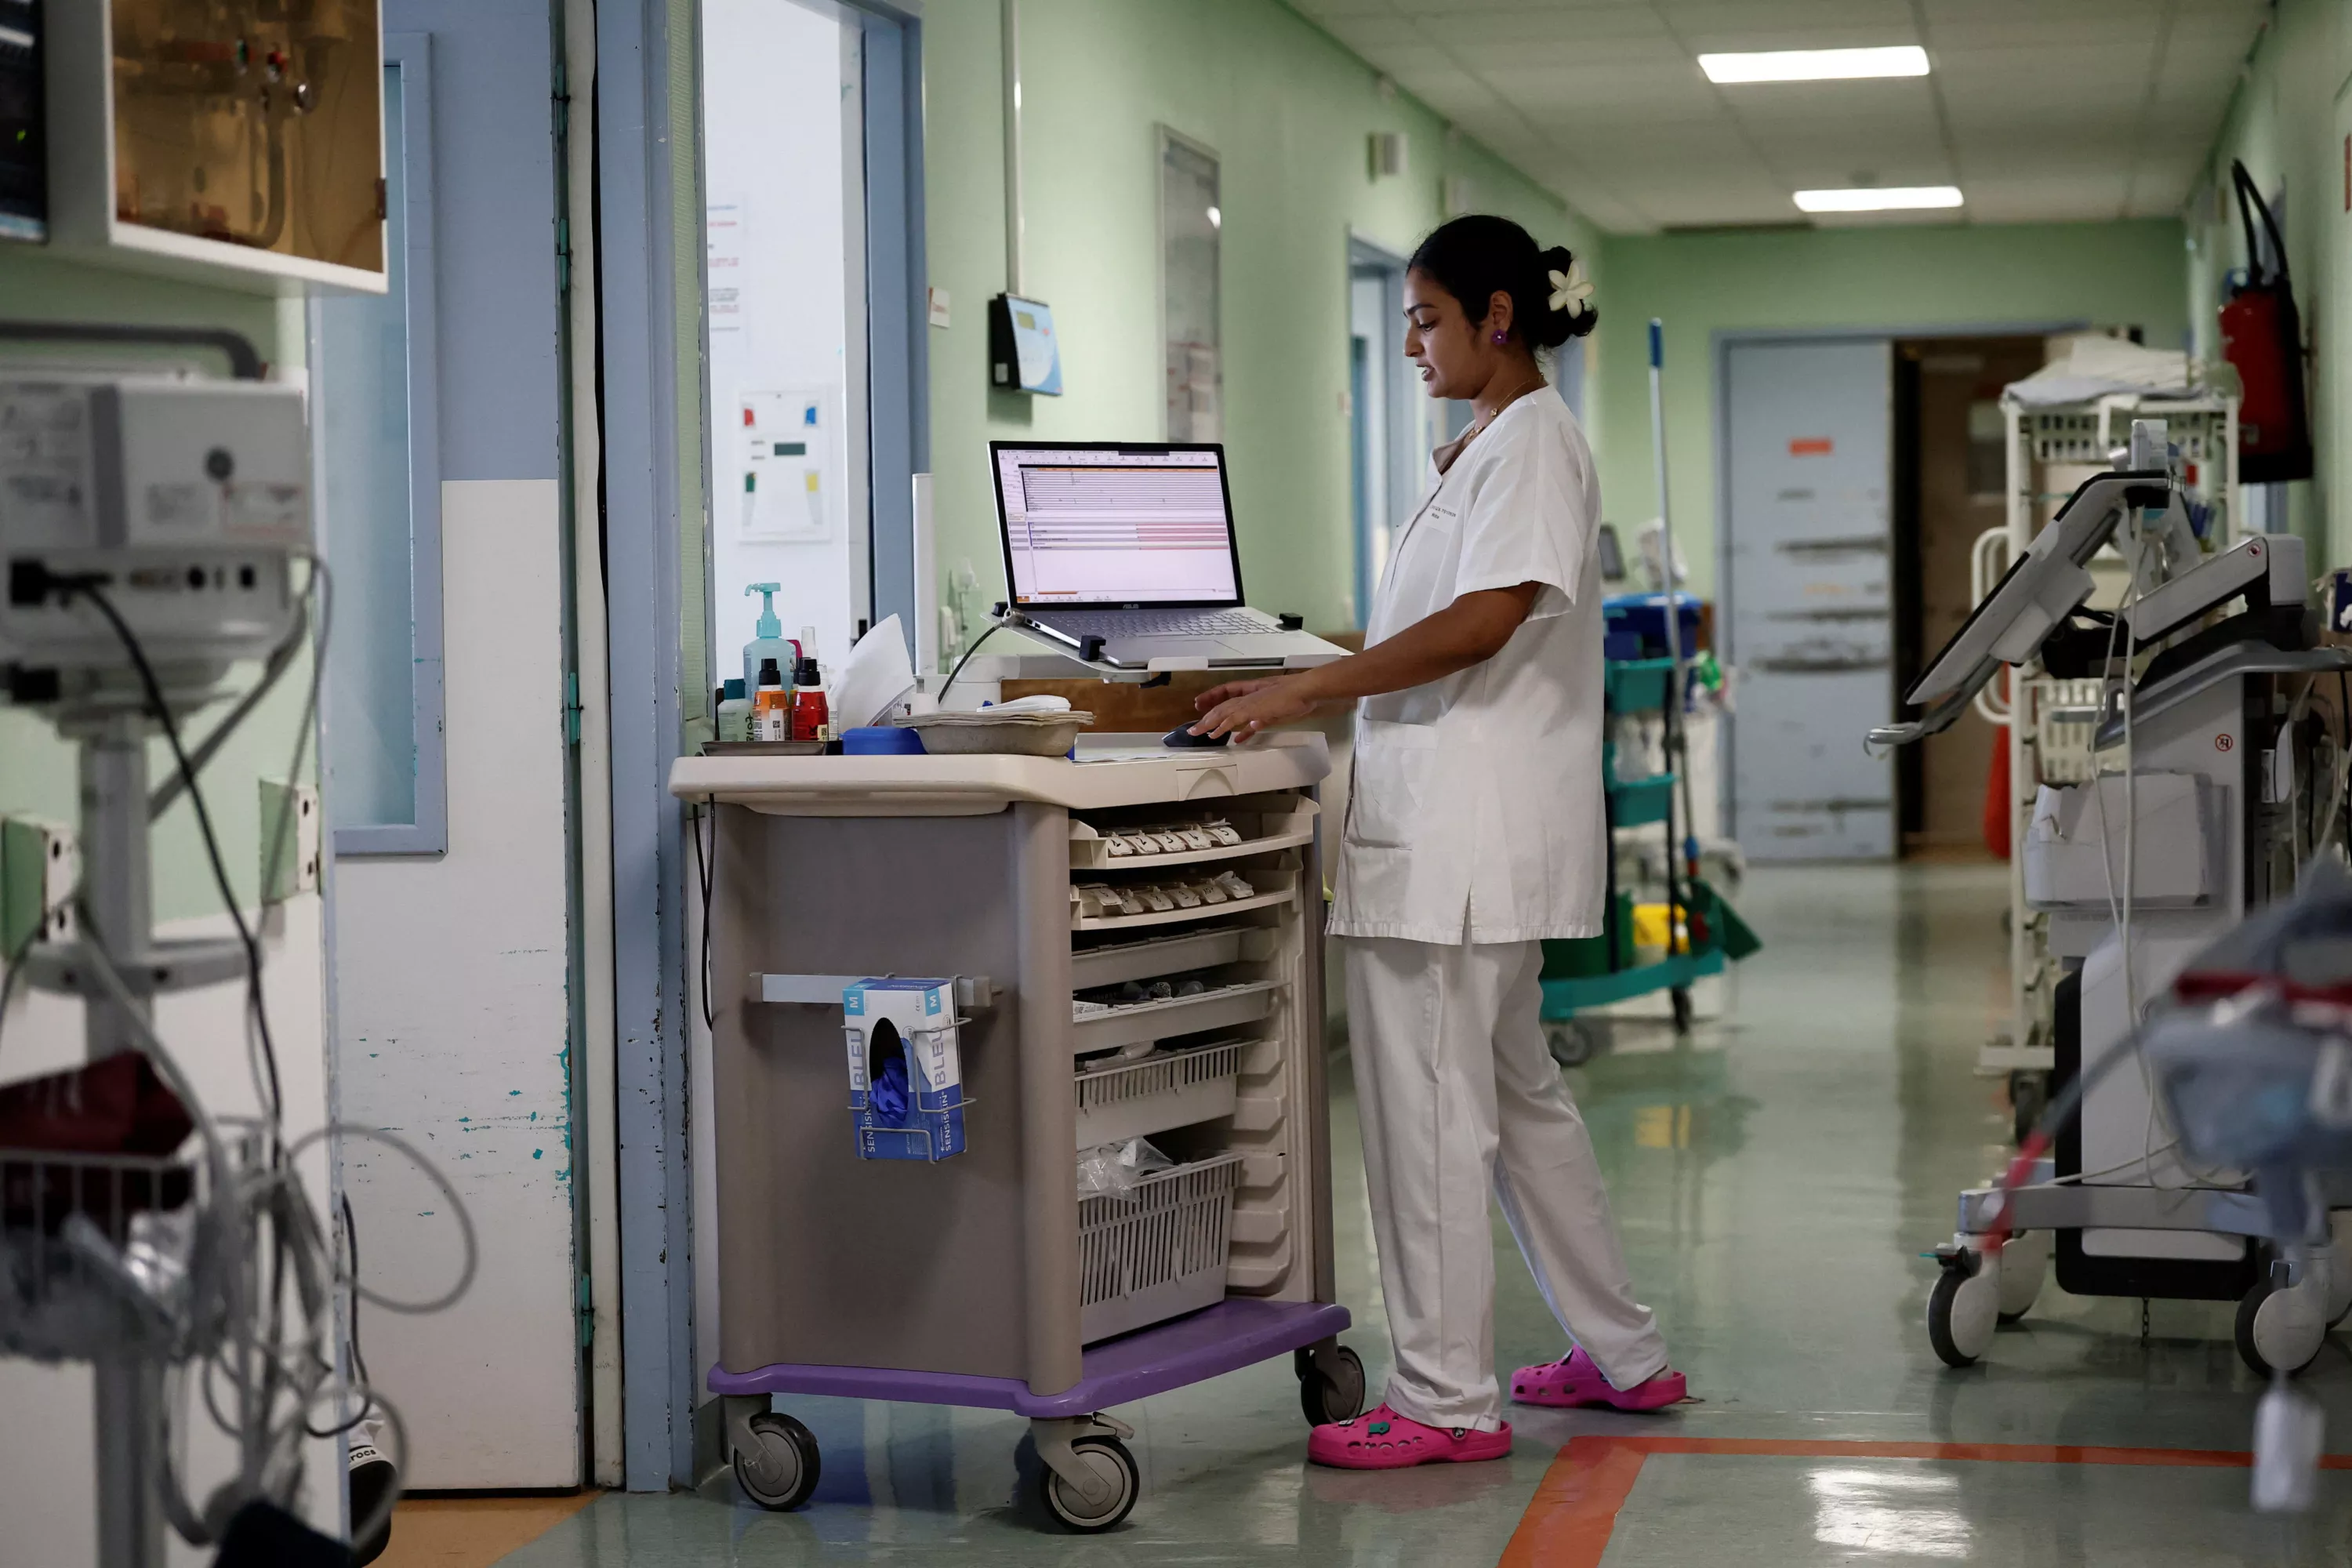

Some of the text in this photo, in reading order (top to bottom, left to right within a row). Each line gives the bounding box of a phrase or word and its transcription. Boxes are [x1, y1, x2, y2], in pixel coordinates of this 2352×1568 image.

[1188, 832, 1199, 840] 4
[1218, 827, 1229, 836] 5
[1135, 837, 1146, 845] 2
[1161, 834, 1174, 844] 3
[849, 996, 858, 1008] M
[930, 994, 937, 1007] M
[931, 1025, 946, 1087] BLEU
[349, 1450, 376, 1463] rocs
